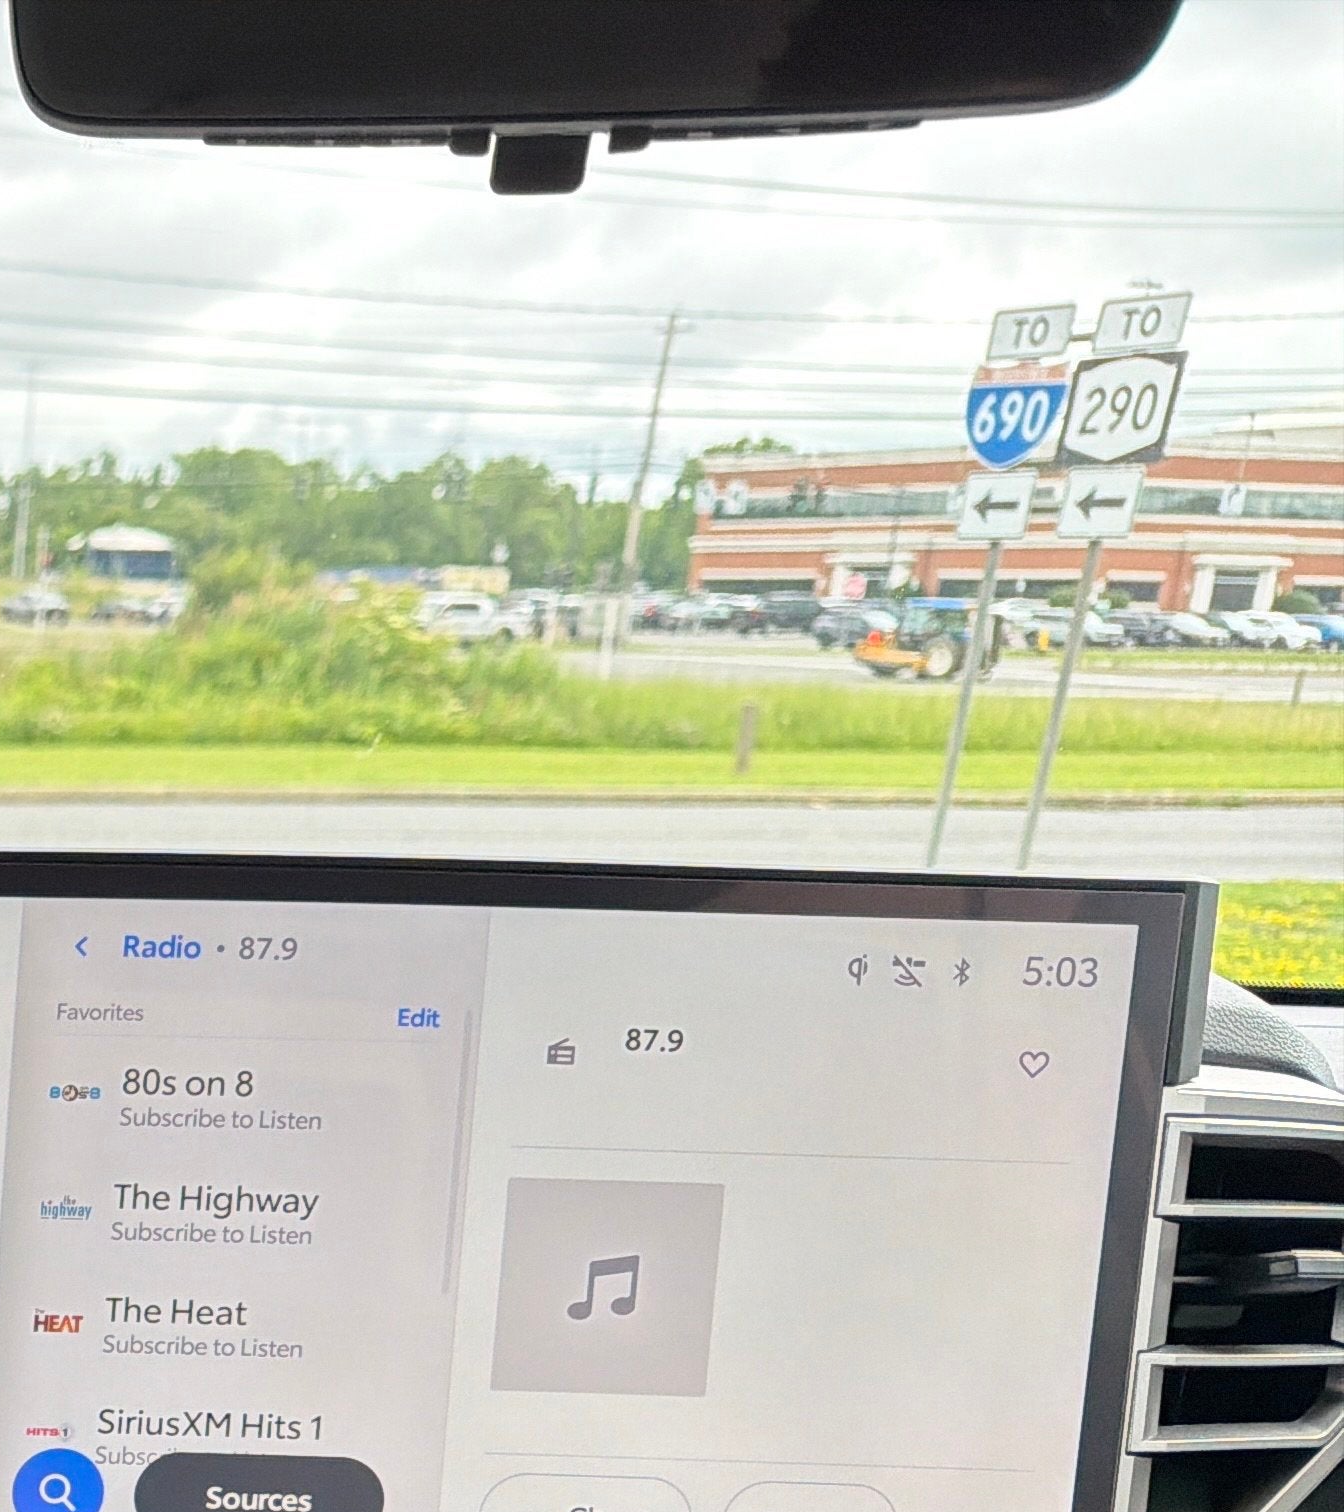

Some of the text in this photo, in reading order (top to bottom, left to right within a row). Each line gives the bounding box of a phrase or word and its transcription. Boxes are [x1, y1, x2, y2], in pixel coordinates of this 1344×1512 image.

[1013, 316, 1050, 350] TO
[1122, 304, 1161, 341] TO
[972, 389, 1051, 444] 690
[1078, 383, 1159, 436] 290
[122, 934, 298, 961] Radio 87.9
[1021, 957, 1099, 988] 5:03
[56, 1003, 144, 1023] Favorites
[397, 1008, 441, 1028] Edit
[624, 1028, 685, 1053] 87.9
[122, 1068, 255, 1098] 80s on 8
[120, 1107, 323, 1131] Subscribe to Listen
[41, 1200, 93, 1221] highway
[113, 1183, 320, 1220] The Highway
[111, 1222, 313, 1246] Subscribe to Listen
[33, 1315, 84, 1333] HEAT
[106, 1297, 248, 1327] The Heat
[102, 1335, 304, 1360] Subscribe to Listen
[25, 1428, 60, 1437] HITS
[97, 1408, 323, 1441] SiriusXM Hits 1
[205, 1486, 313, 1512] Sources
